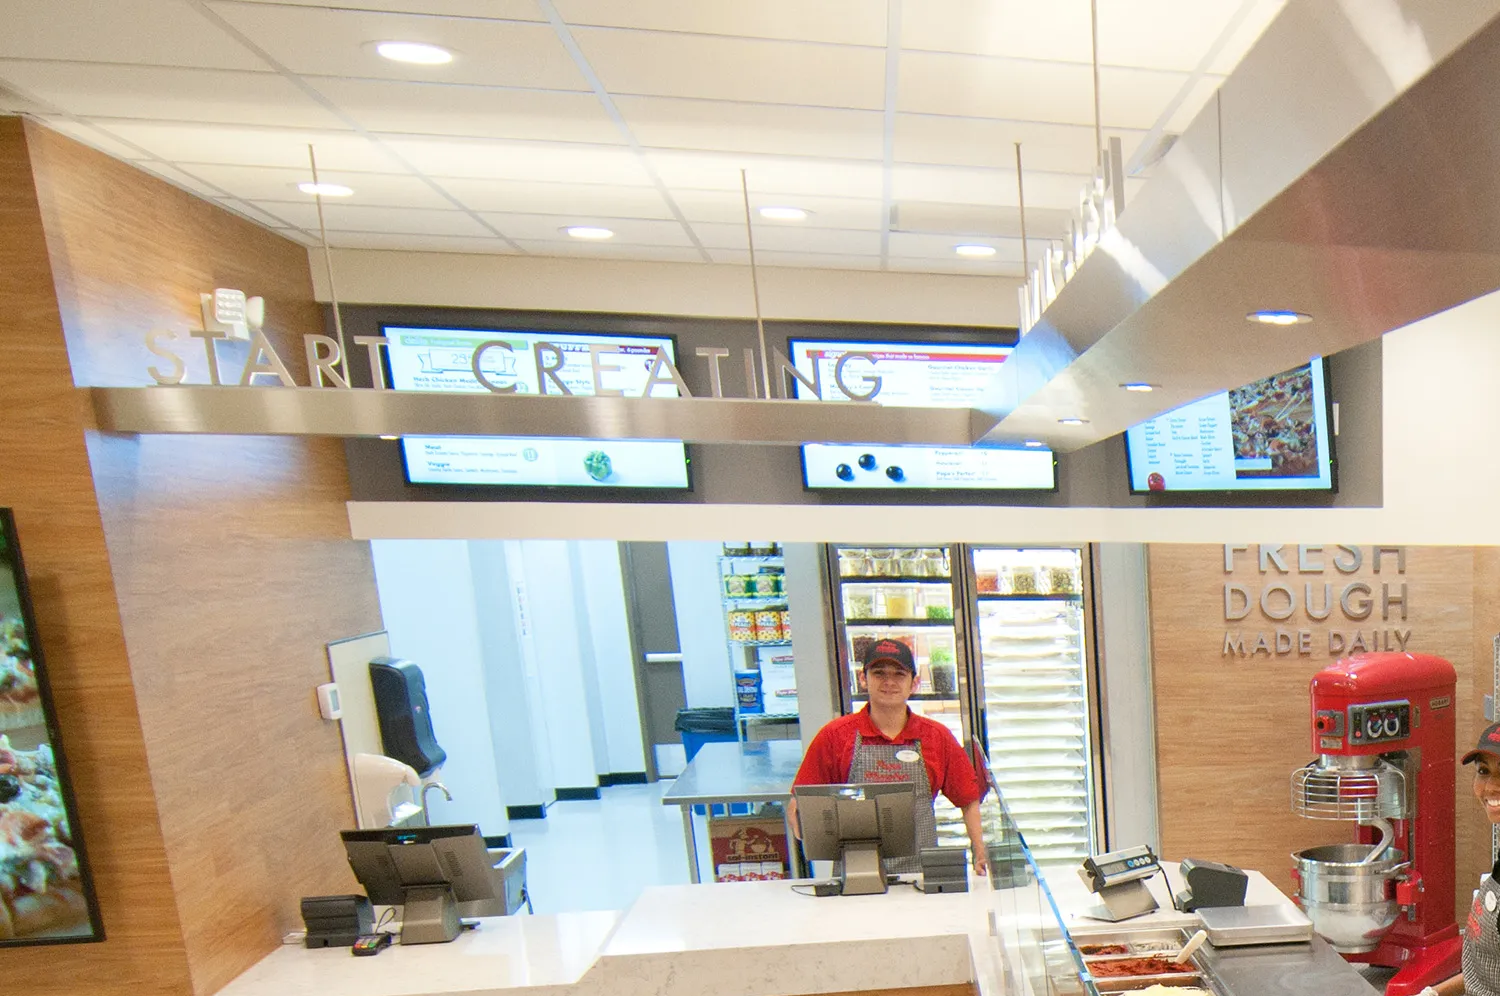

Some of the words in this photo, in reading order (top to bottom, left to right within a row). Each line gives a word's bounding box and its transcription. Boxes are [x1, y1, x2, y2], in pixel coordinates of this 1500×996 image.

[145, 328, 390, 390] START
[472, 340, 882, 402] CREATING
[1224, 544, 1406, 574] FRESH
[1224, 582, 1408, 622] DOUGH
[1222, 630, 1313, 658] MADE
[1329, 630, 1412, 656] DAILY
